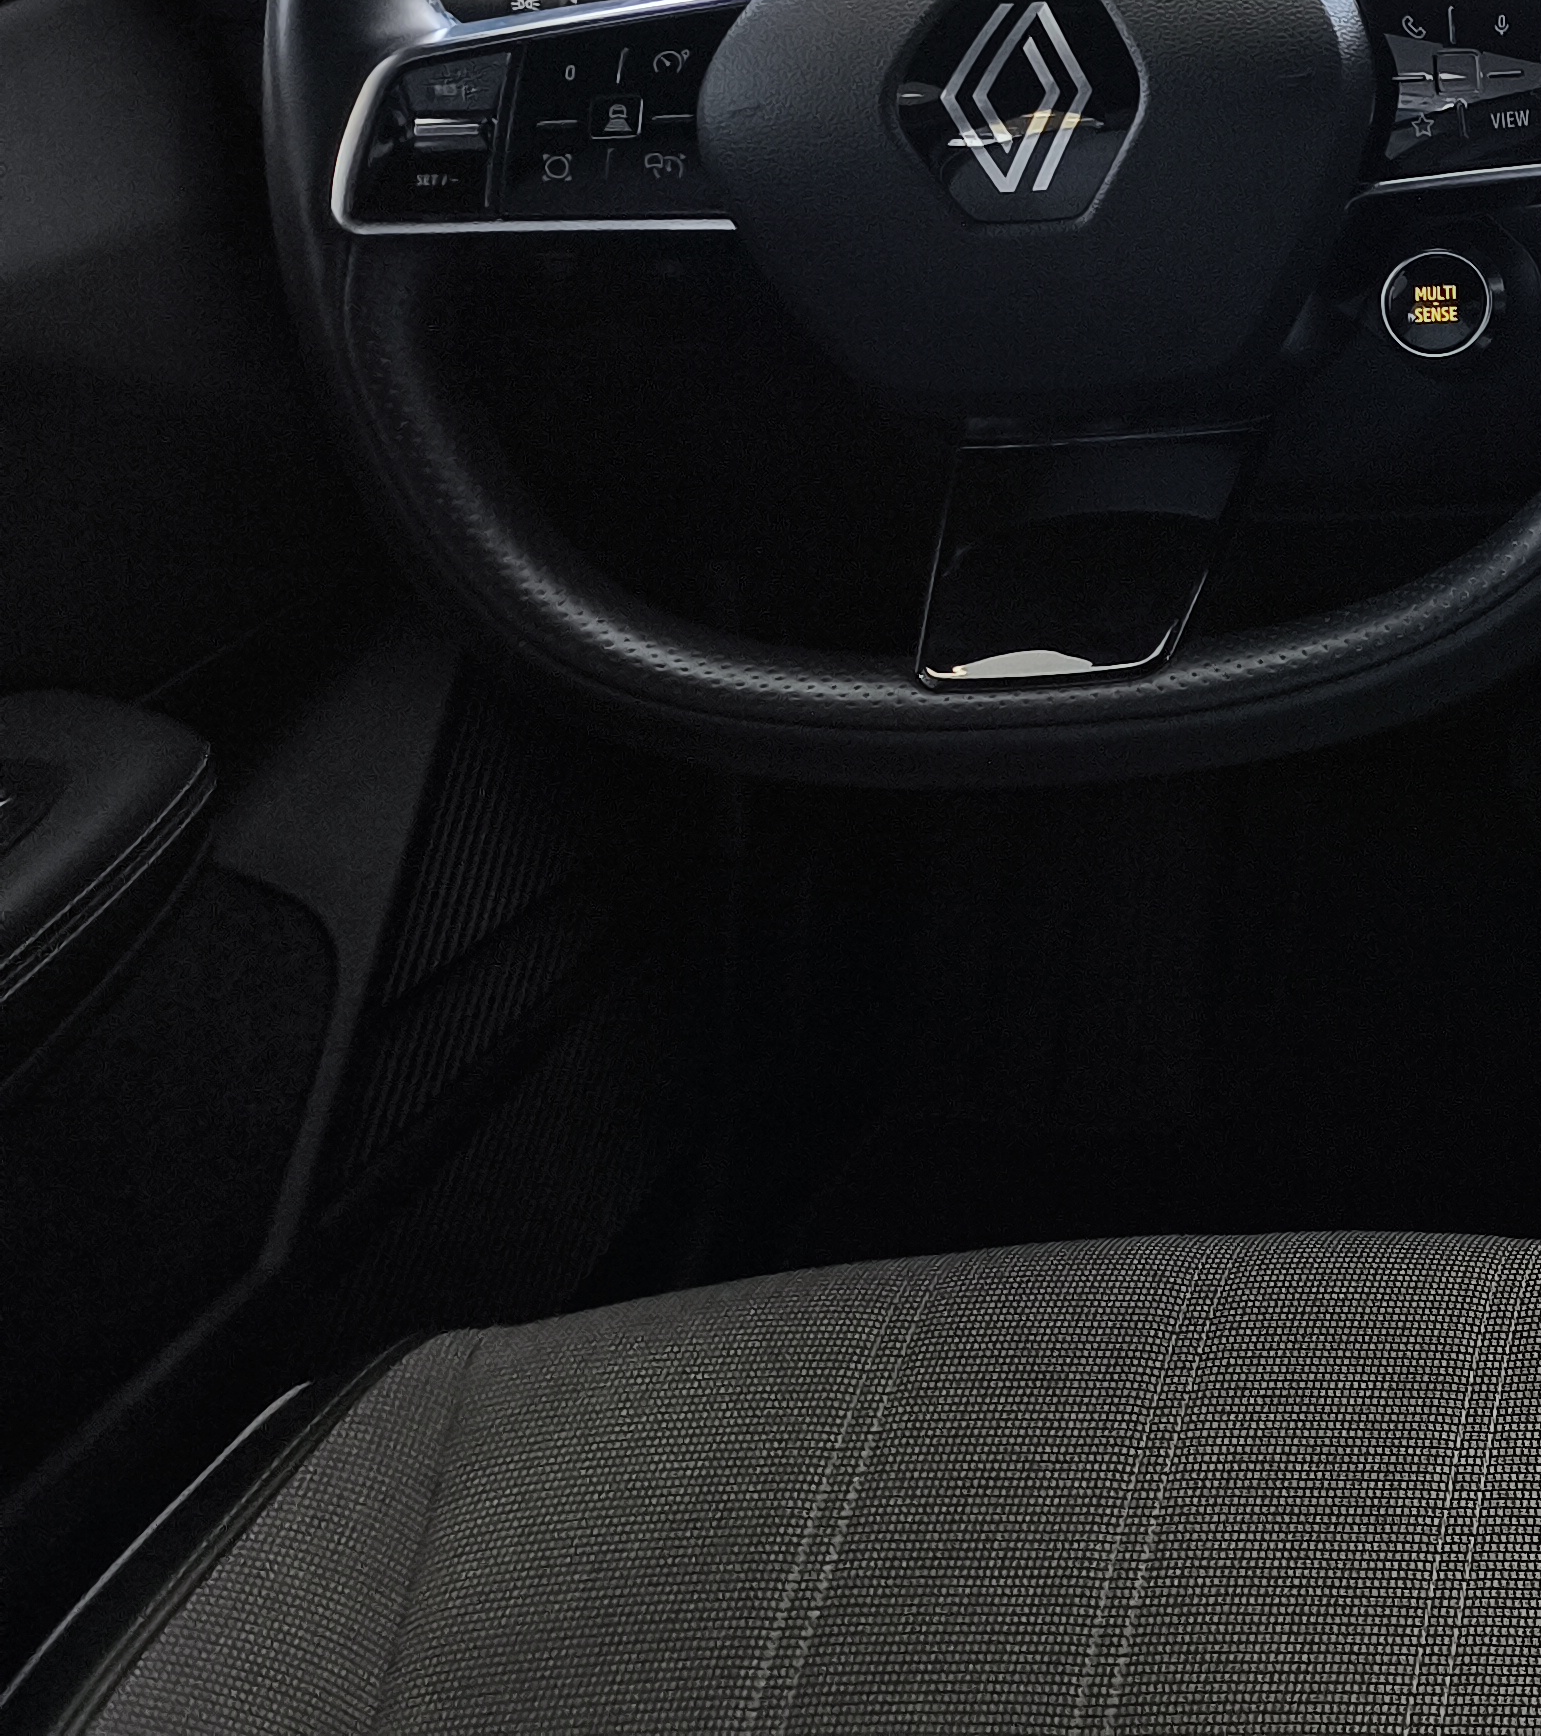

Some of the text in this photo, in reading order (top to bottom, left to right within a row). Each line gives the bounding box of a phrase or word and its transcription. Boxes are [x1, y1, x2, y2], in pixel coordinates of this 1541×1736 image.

[1490, 109, 1530, 129] VIEW
[1414, 284, 1457, 301] MULTI
[1414, 306, 1458, 324] SENSE
